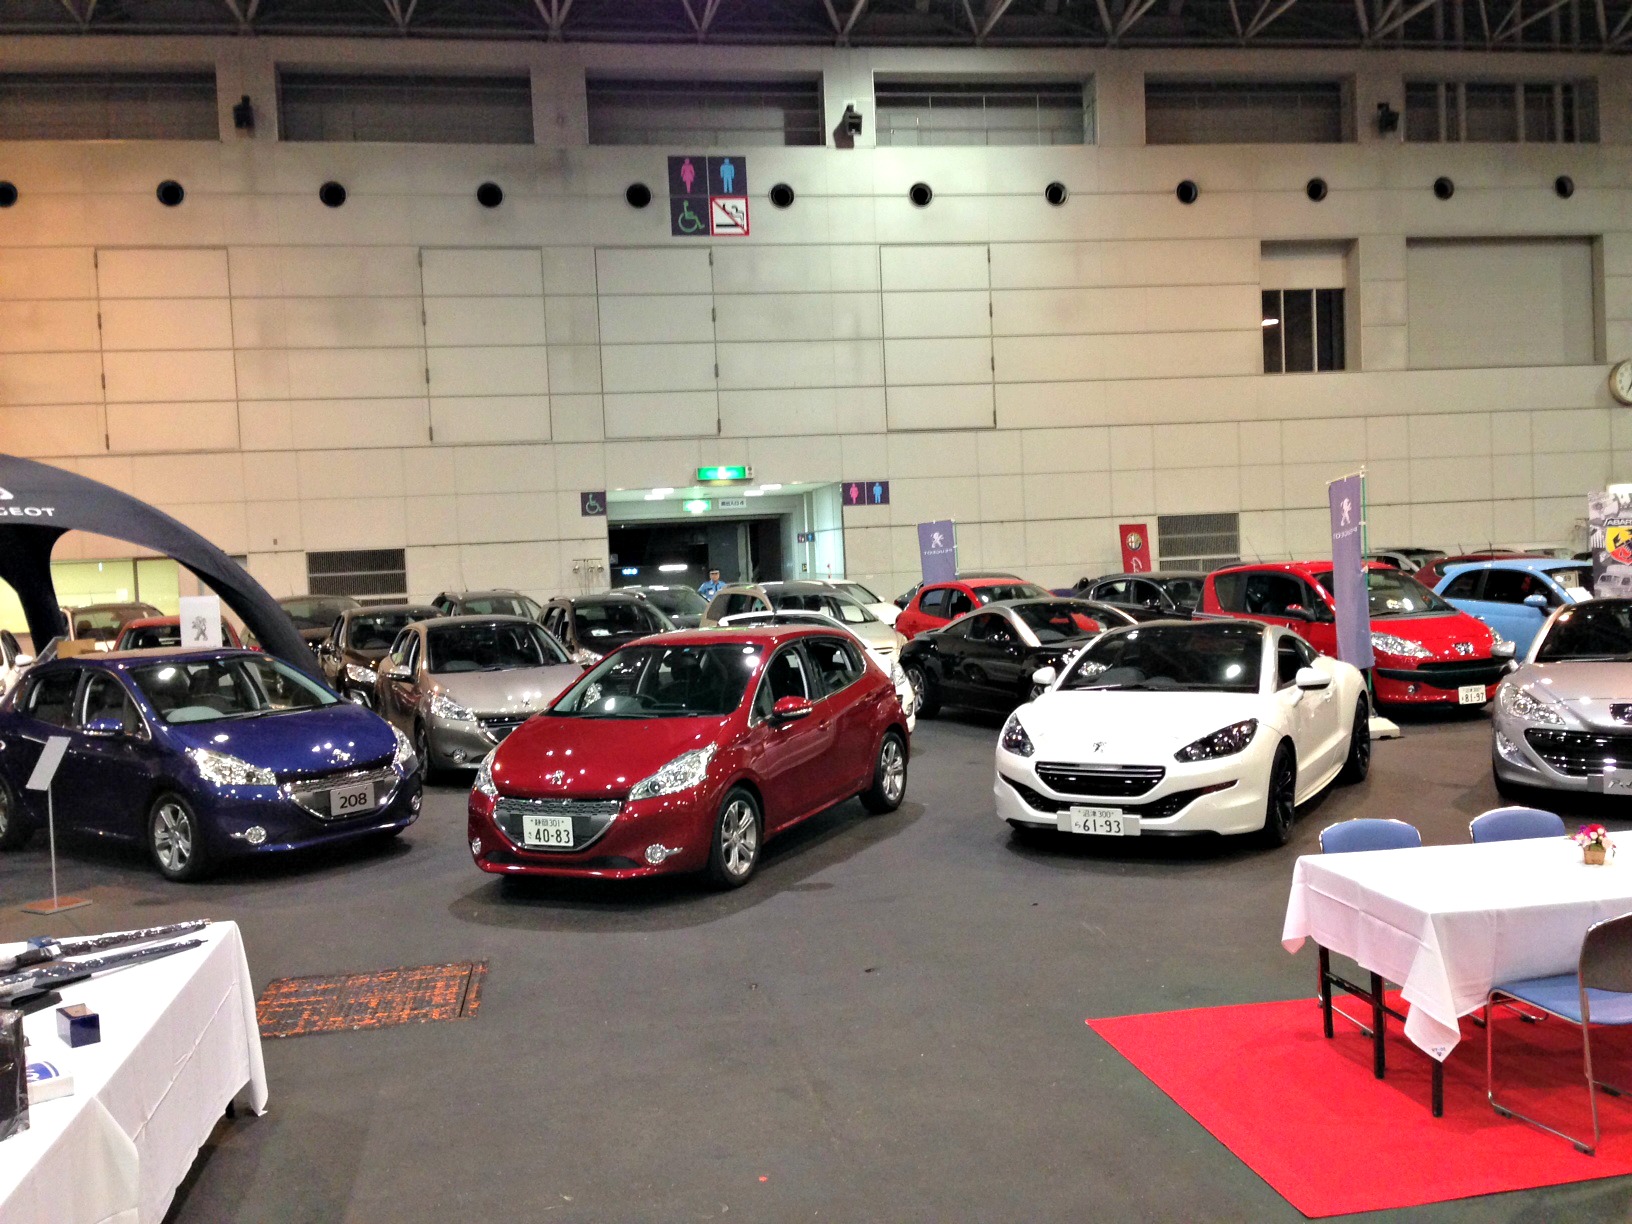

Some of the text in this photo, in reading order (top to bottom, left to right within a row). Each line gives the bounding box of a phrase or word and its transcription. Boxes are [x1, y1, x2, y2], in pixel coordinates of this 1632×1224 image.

[340, 793, 367, 809] 208
[549, 819, 560, 827] 301
[1083, 819, 1121, 833] 61-93
[535, 828, 570, 844] 40-83
